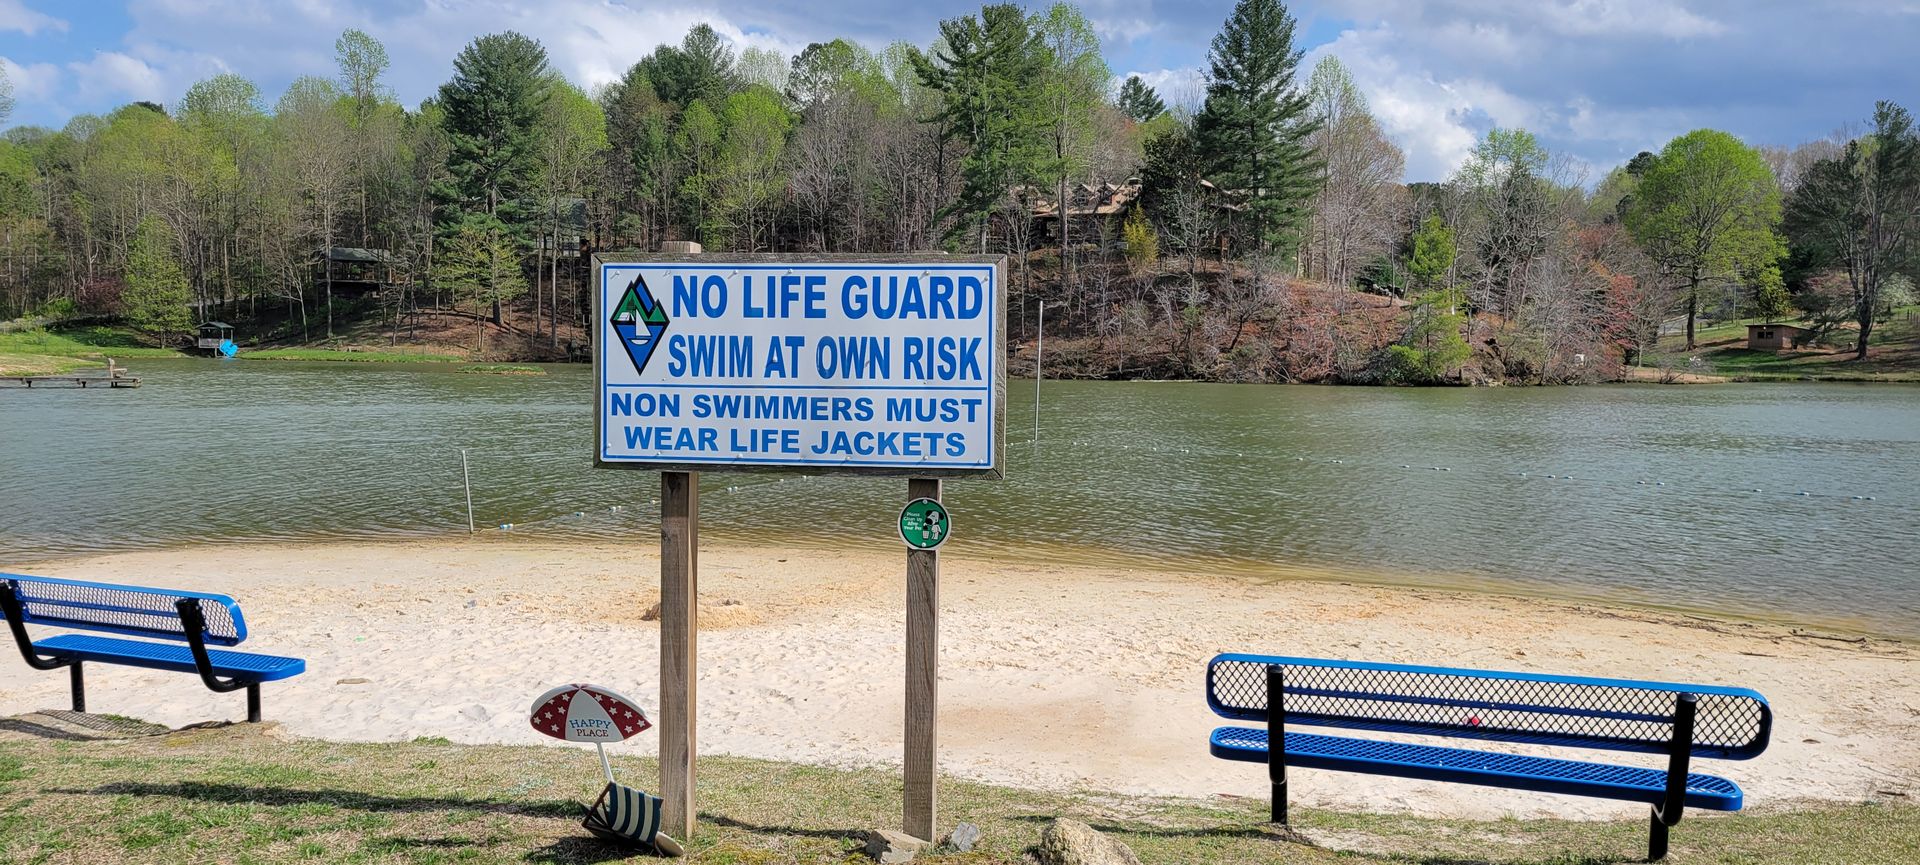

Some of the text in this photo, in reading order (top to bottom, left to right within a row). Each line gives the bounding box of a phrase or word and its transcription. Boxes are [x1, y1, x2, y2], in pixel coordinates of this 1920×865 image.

[673, 275, 983, 319] NO LIFE GUARD
[668, 334, 982, 380] SWIM AT OWN RISK
[611, 393, 982, 422] NON SWIMMERS MUST
[624, 426, 965, 457] WEAR LIFE JACKETS
[569, 719, 611, 729] HAPPY
[576, 729, 609, 737] PLACE
